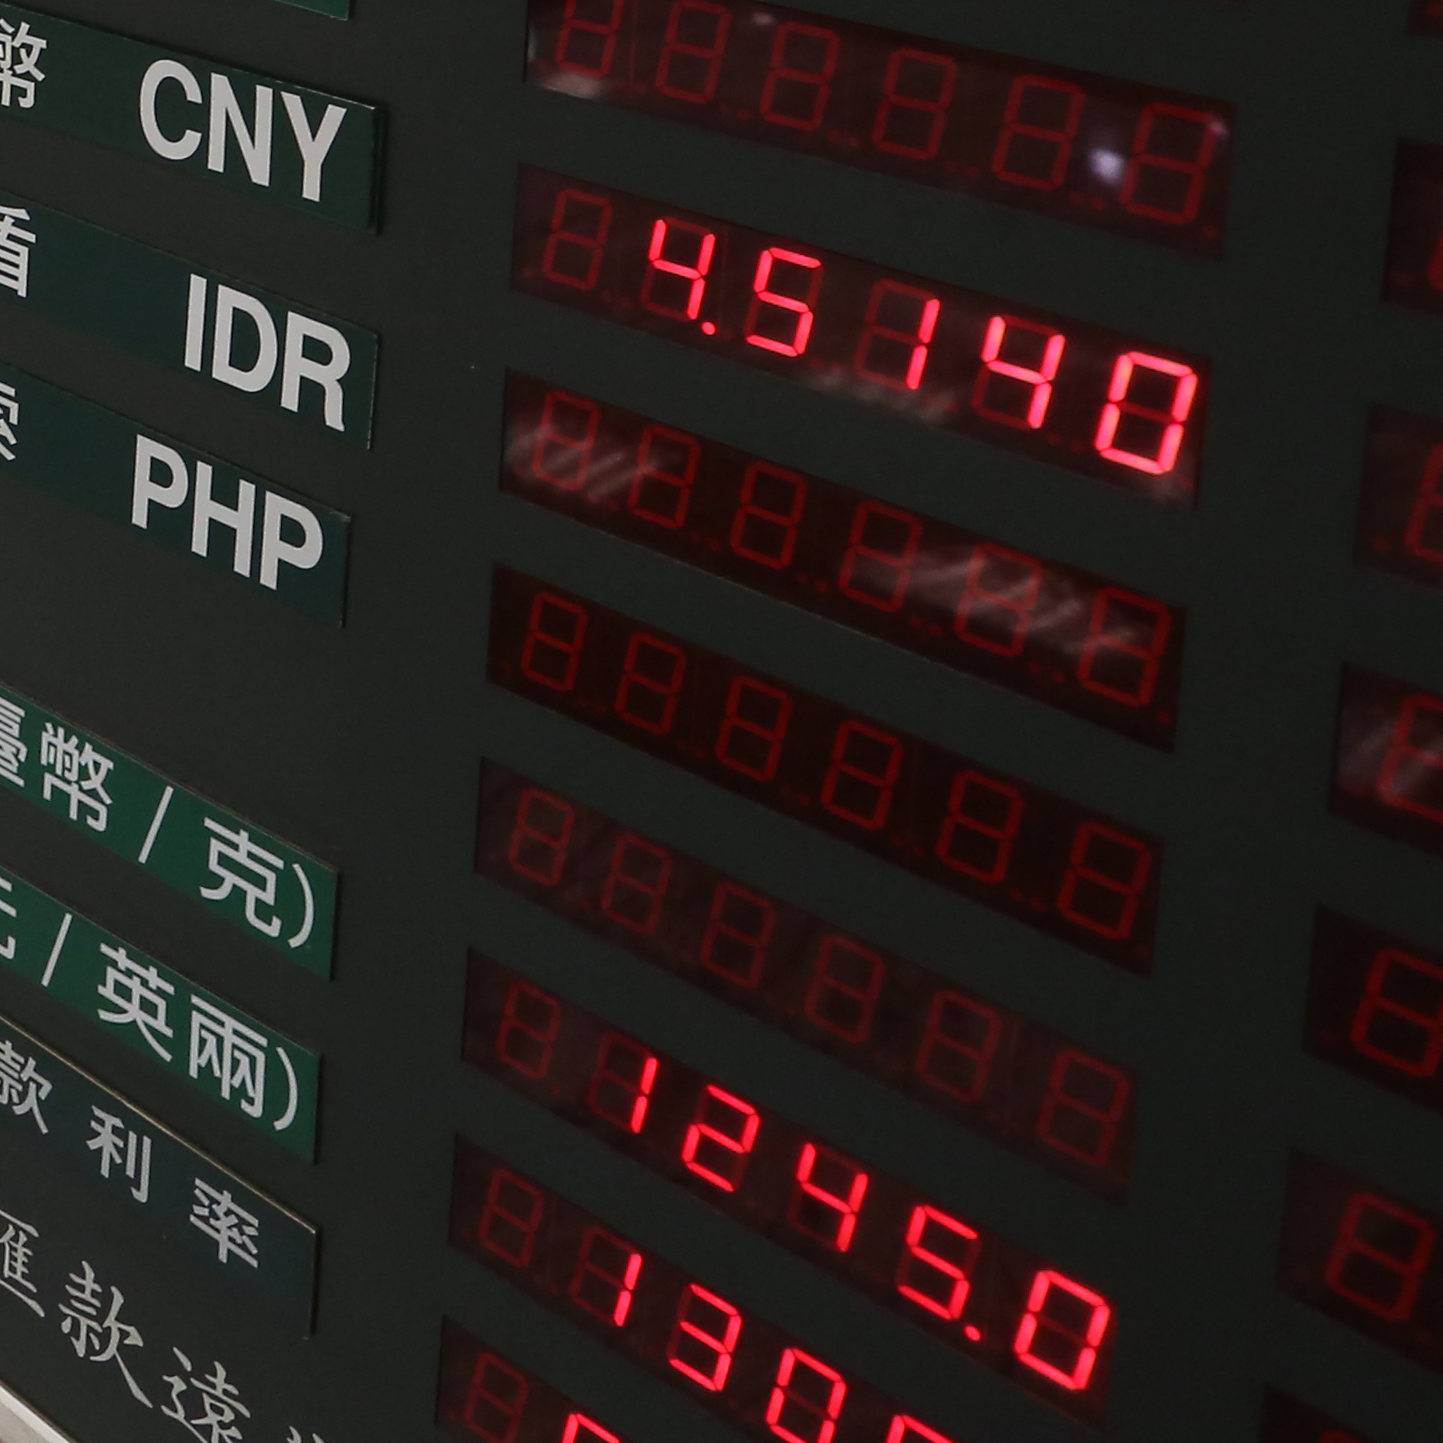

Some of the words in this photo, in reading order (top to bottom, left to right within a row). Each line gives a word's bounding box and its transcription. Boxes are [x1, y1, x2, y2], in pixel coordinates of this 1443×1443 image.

[140, 60, 346, 202] CNY
[185, 274, 350, 431] IDR
[649, 220, 1197, 474] 4.5140
[132, 434, 322, 587] PHP
[631, 1058, 1110, 1389] 1245.0
[614, 1254, 952, 1443] 130
